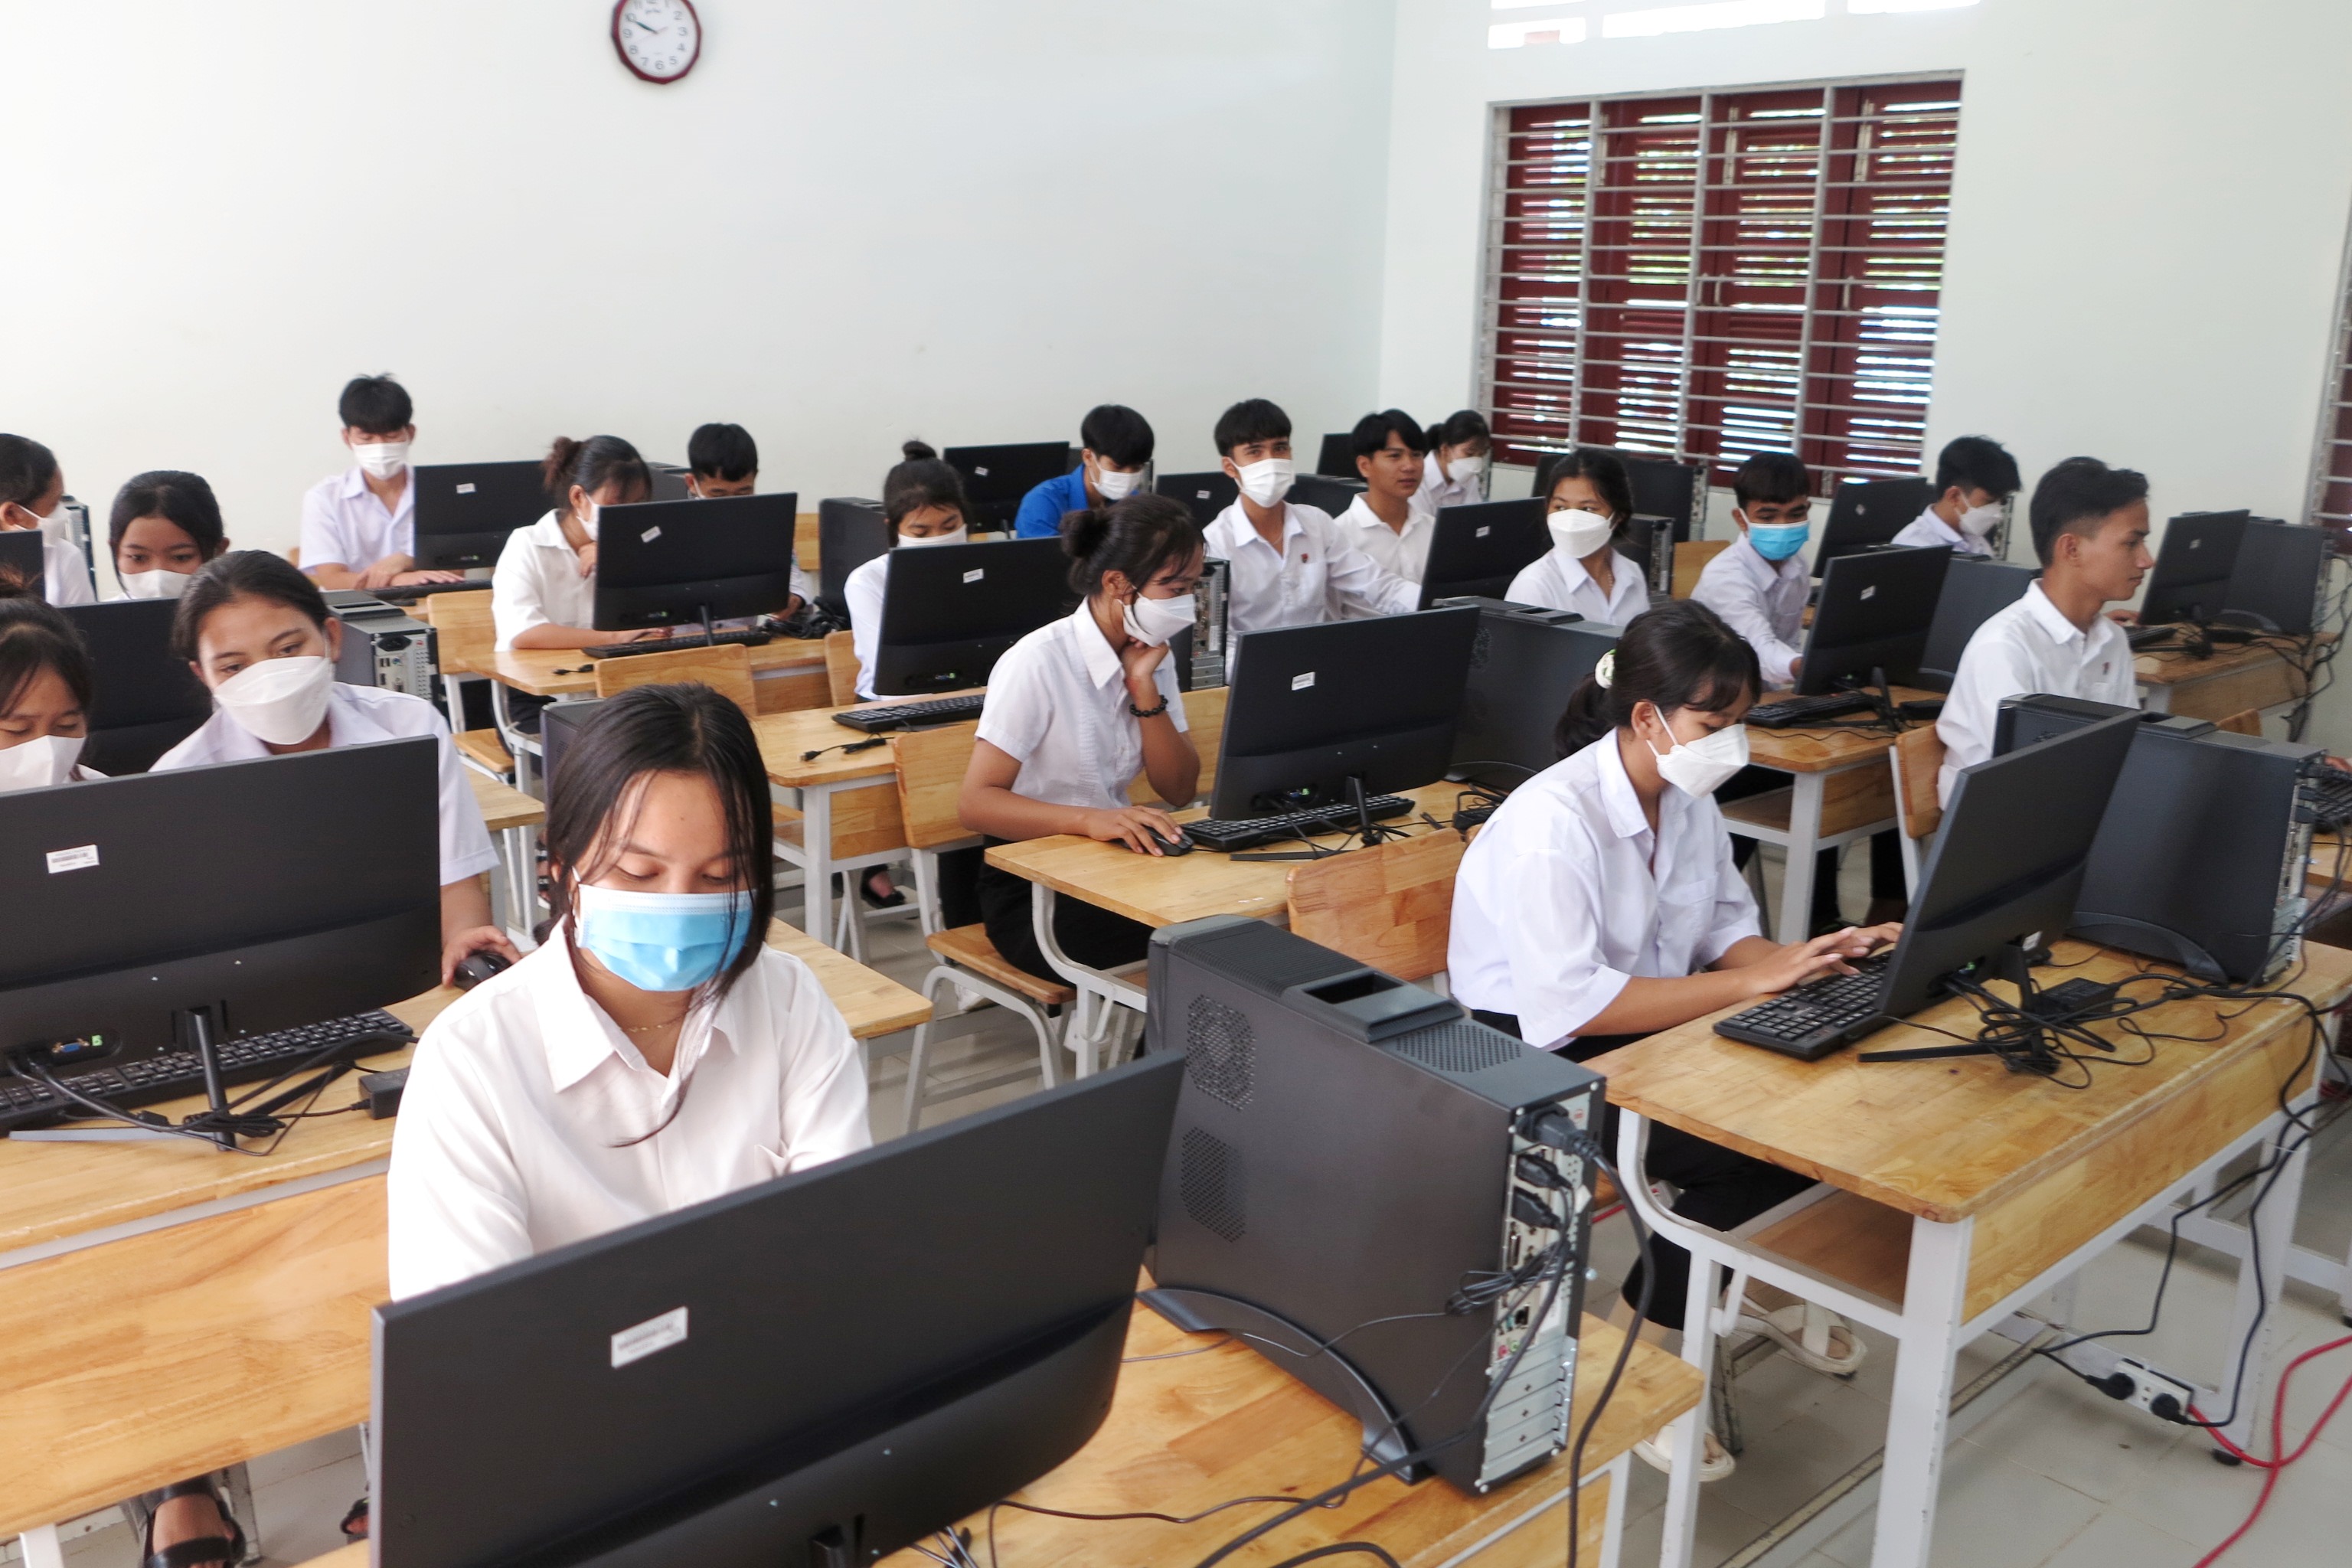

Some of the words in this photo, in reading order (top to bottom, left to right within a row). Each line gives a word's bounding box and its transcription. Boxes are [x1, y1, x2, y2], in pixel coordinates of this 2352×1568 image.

[673, 10, 682, 21] 2
[622, 28, 632, 38] 9
[678, 26, 688, 37] 3
[628, 44, 639, 55] 8
[676, 41, 686, 51] 4
[640, 56, 650, 67] 7
[654, 60, 665, 70] 6
[668, 55, 678, 65] 5
